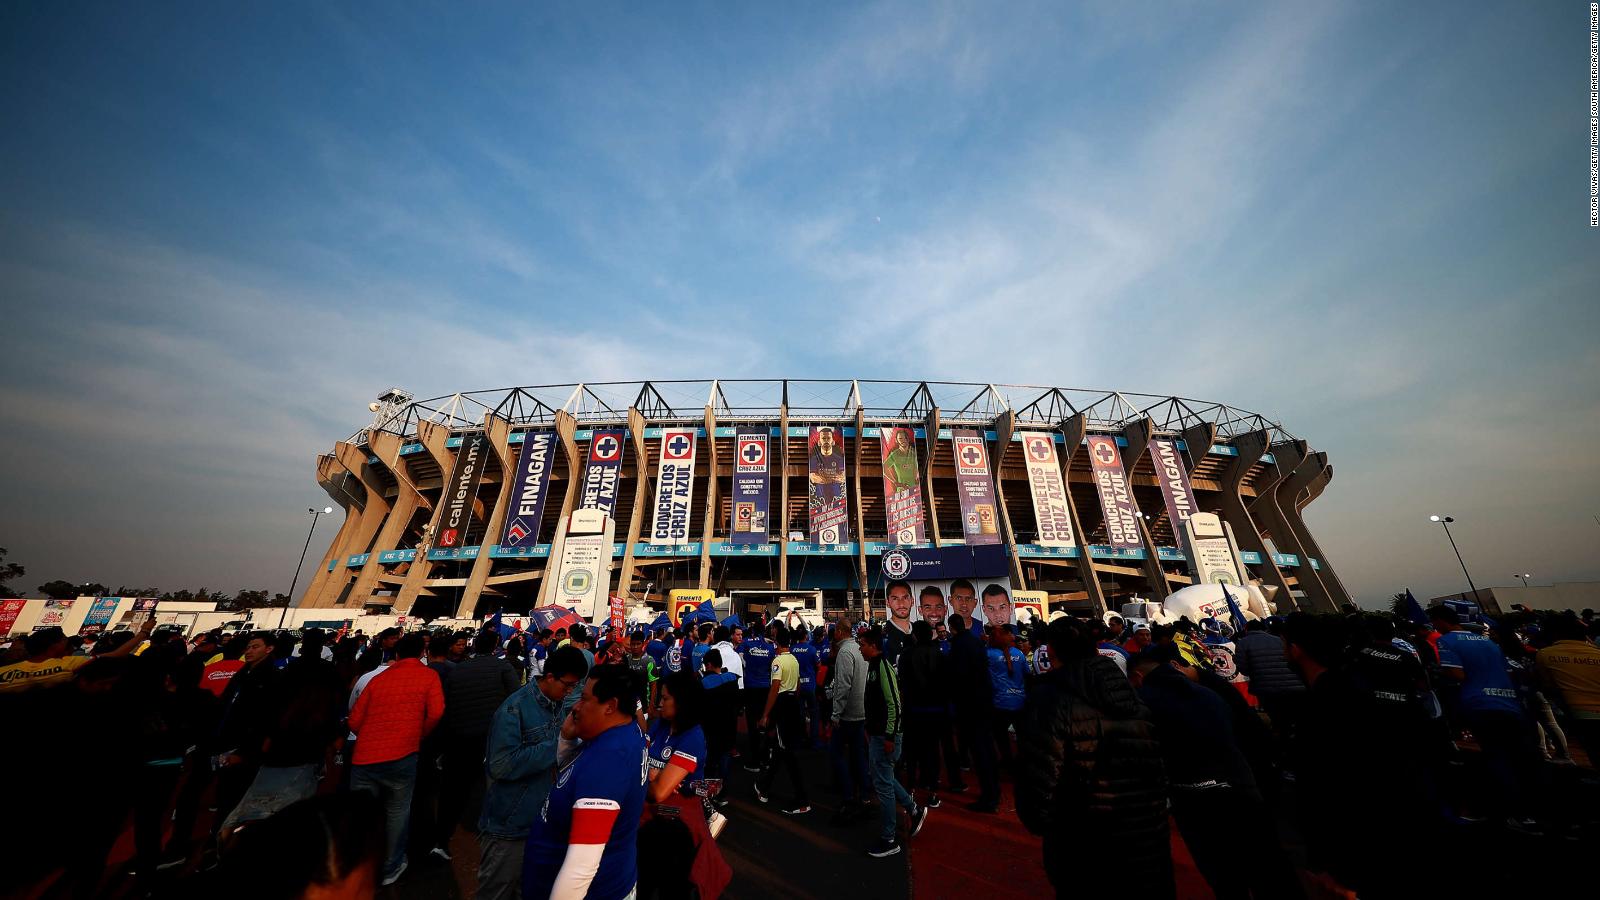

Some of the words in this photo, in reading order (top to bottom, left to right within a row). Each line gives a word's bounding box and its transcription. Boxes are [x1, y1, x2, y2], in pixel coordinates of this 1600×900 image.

[449, 438, 481, 528] caliente.mx
[518, 434, 550, 516] FINAGAM
[600, 465, 618, 499] AZUL
[674, 464, 691, 497] AZUL
[1044, 468, 1062, 500] AZUL
[1110, 471, 1131, 503] AZUL
[1156, 441, 1191, 521] FINAGAM
[655, 464, 675, 539] CONCRETOS
[670, 501, 688, 539] CRUZ
[1031, 467, 1056, 541] CONCRETOS
[1097, 470, 1125, 544] CONCRETOS
[1050, 504, 1071, 542] CRUZ
[1118, 507, 1140, 544] CRUZ
[1369, 649, 1401, 661] telcel
[1548, 655, 1570, 664] CLUB
[1483, 687, 1517, 698] TECATE
